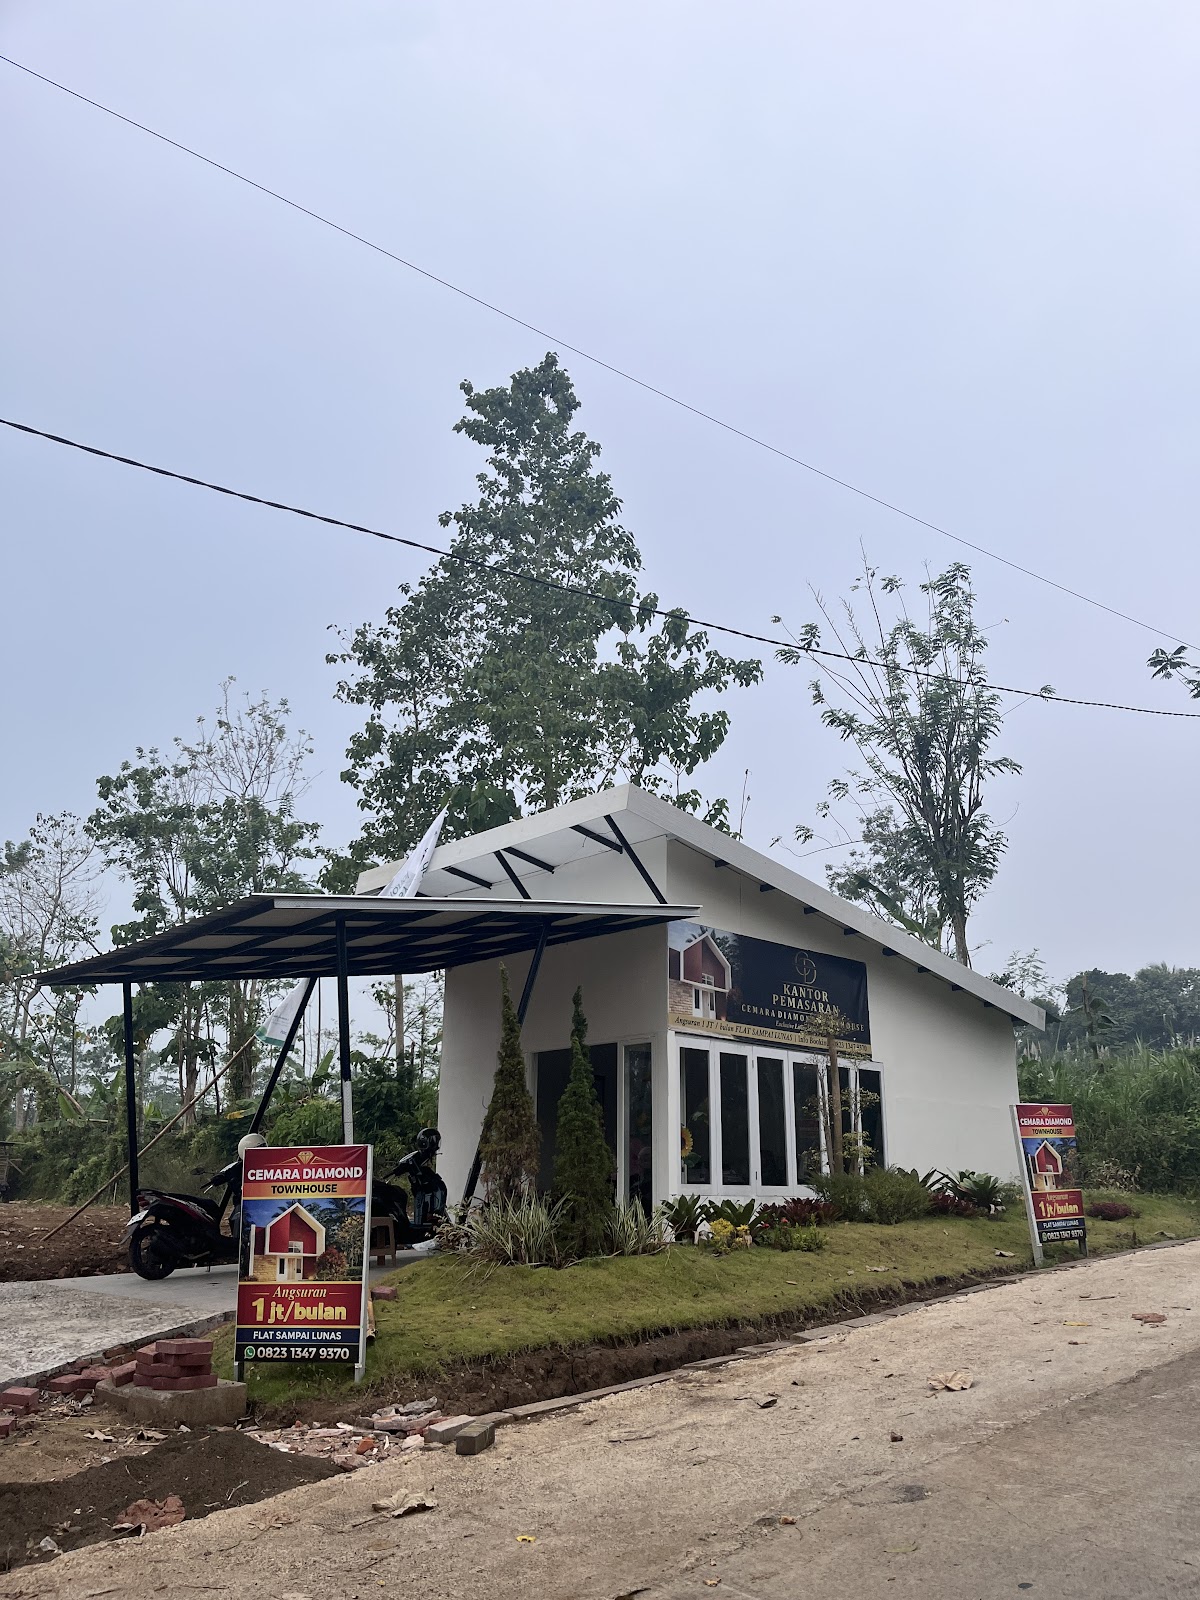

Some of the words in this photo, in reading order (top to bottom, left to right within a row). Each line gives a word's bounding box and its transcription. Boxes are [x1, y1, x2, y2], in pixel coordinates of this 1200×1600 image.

[783, 984, 828, 1002] KANTOR
[772, 994, 839, 1016] PEMASARAN
[741, 1003, 776, 1018] CEMARA
[777, 1010, 820, 1026] DIAMO
[675, 1015, 701, 1028] Angsuran
[705, 1020, 715, 1029] JT
[719, 1022, 735, 1033] bulan
[735, 1025, 752, 1035] FLAT
[752, 1028, 774, 1039] SAMPAI
[774, 1031, 793, 1042] LUNAS
[809, 1036, 830, 1047] Bookin
[1020, 1117, 1045, 1126] CEMARA
[1045, 1117, 1073, 1126] DIAMOND
[247, 1168, 301, 1181] CEMARA
[302, 1166, 363, 1179] DIAMOND
[271, 1184, 338, 1194] TOWNHOUSE
[1039, 1201, 1046, 1217] 1
[1046, 1202, 1079, 1218] jt/bulan
[1060, 1231, 1071, 1239] 1347
[272, 1286, 327, 1301] Angsuran
[251, 1297, 265, 1322] 1
[267, 1300, 347, 1324] jt/bulan
[253, 1331, 274, 1340] FLAT
[275, 1331, 310, 1340] SAMPAI
[311, 1331, 342, 1340] LUNAS
[257, 1347, 288, 1359] 0823
[289, 1347, 317, 1359] 1347
[319, 1347, 350, 1359] 9370
